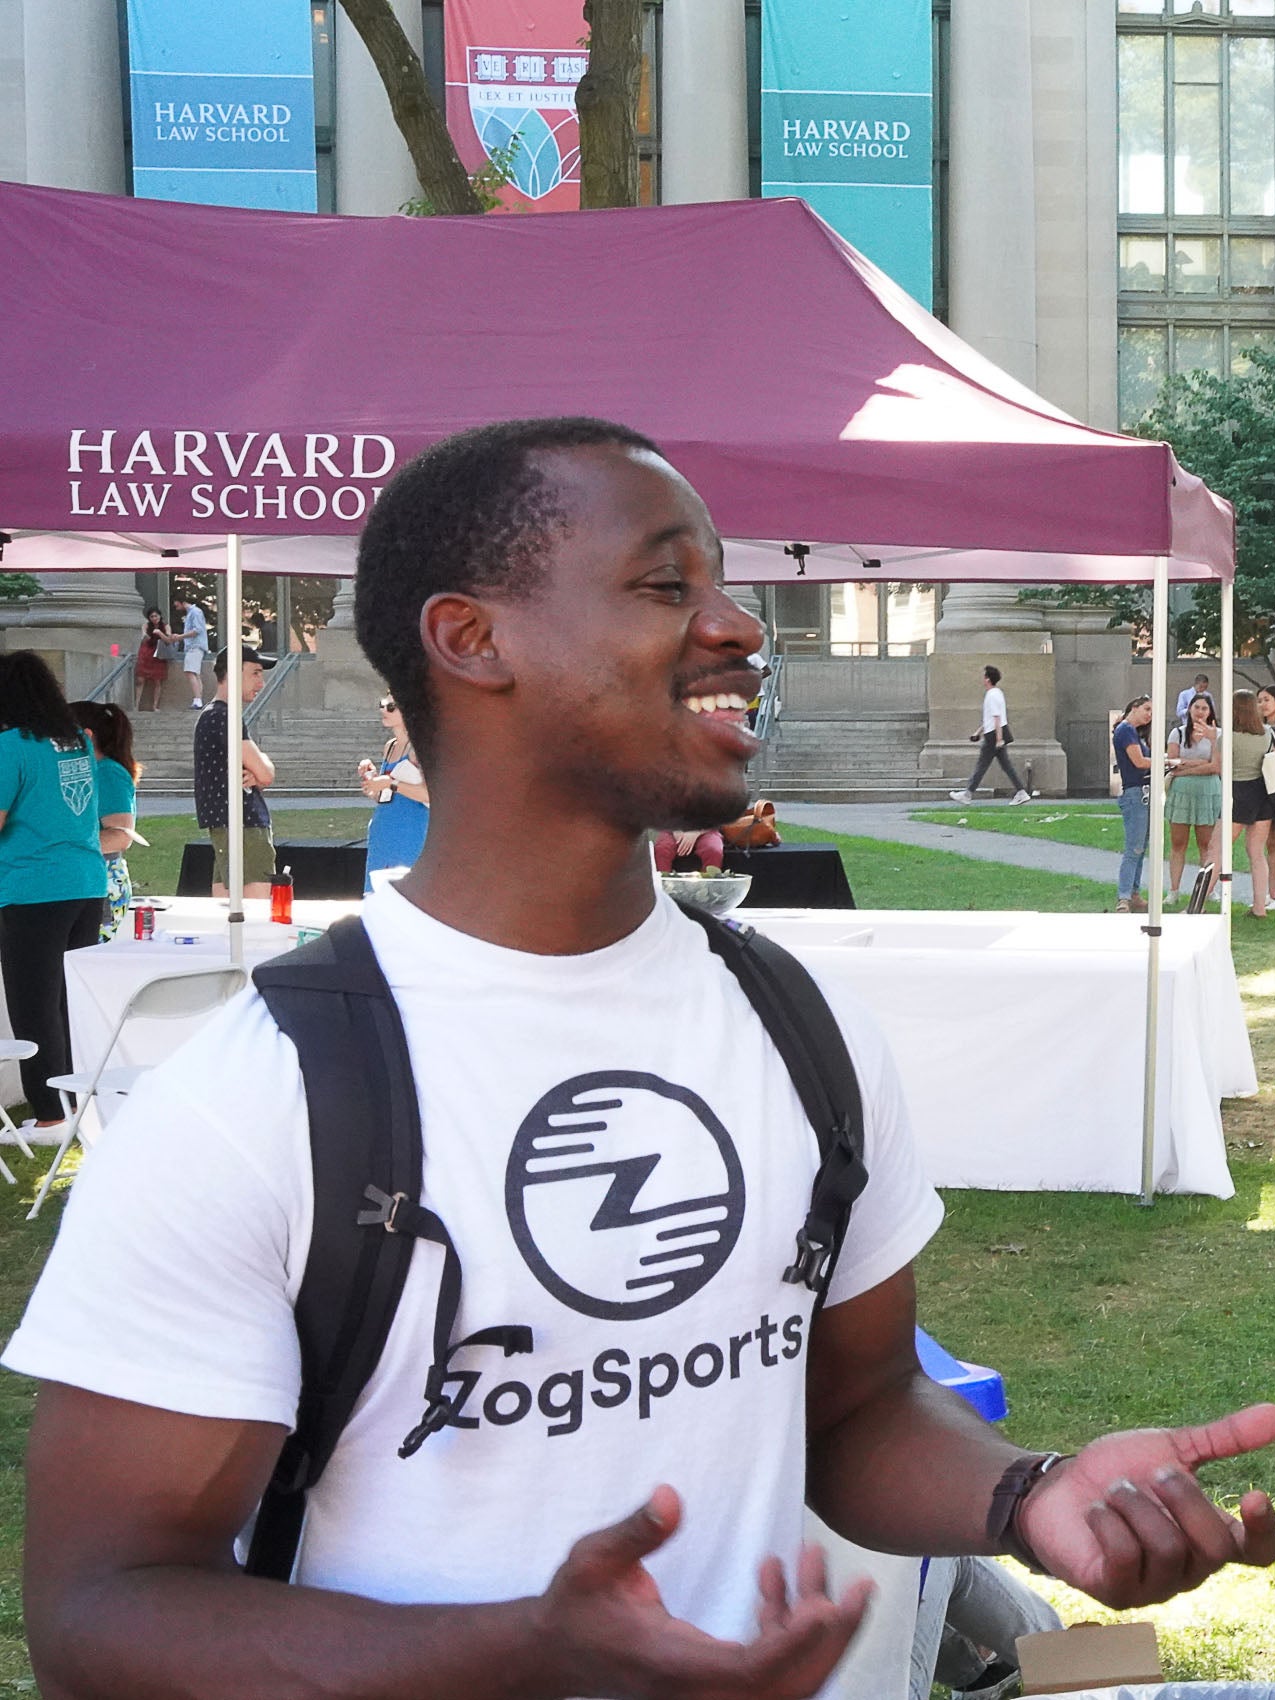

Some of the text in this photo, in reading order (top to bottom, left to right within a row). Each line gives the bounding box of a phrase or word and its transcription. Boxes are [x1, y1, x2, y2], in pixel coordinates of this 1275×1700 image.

[479, 91, 574, 102] LEX ET IUSTIT
[154, 102, 292, 125] HARVARD
[156, 125, 290, 143] LAW SCHOOL
[783, 119, 911, 142] HARVARD
[783, 142, 908, 159] LAW SCHOOL
[67, 429, 396, 479] HARVARD
[69, 480, 384, 521] LAW SCHOO
[443, 1314, 804, 1438] ZogSports
